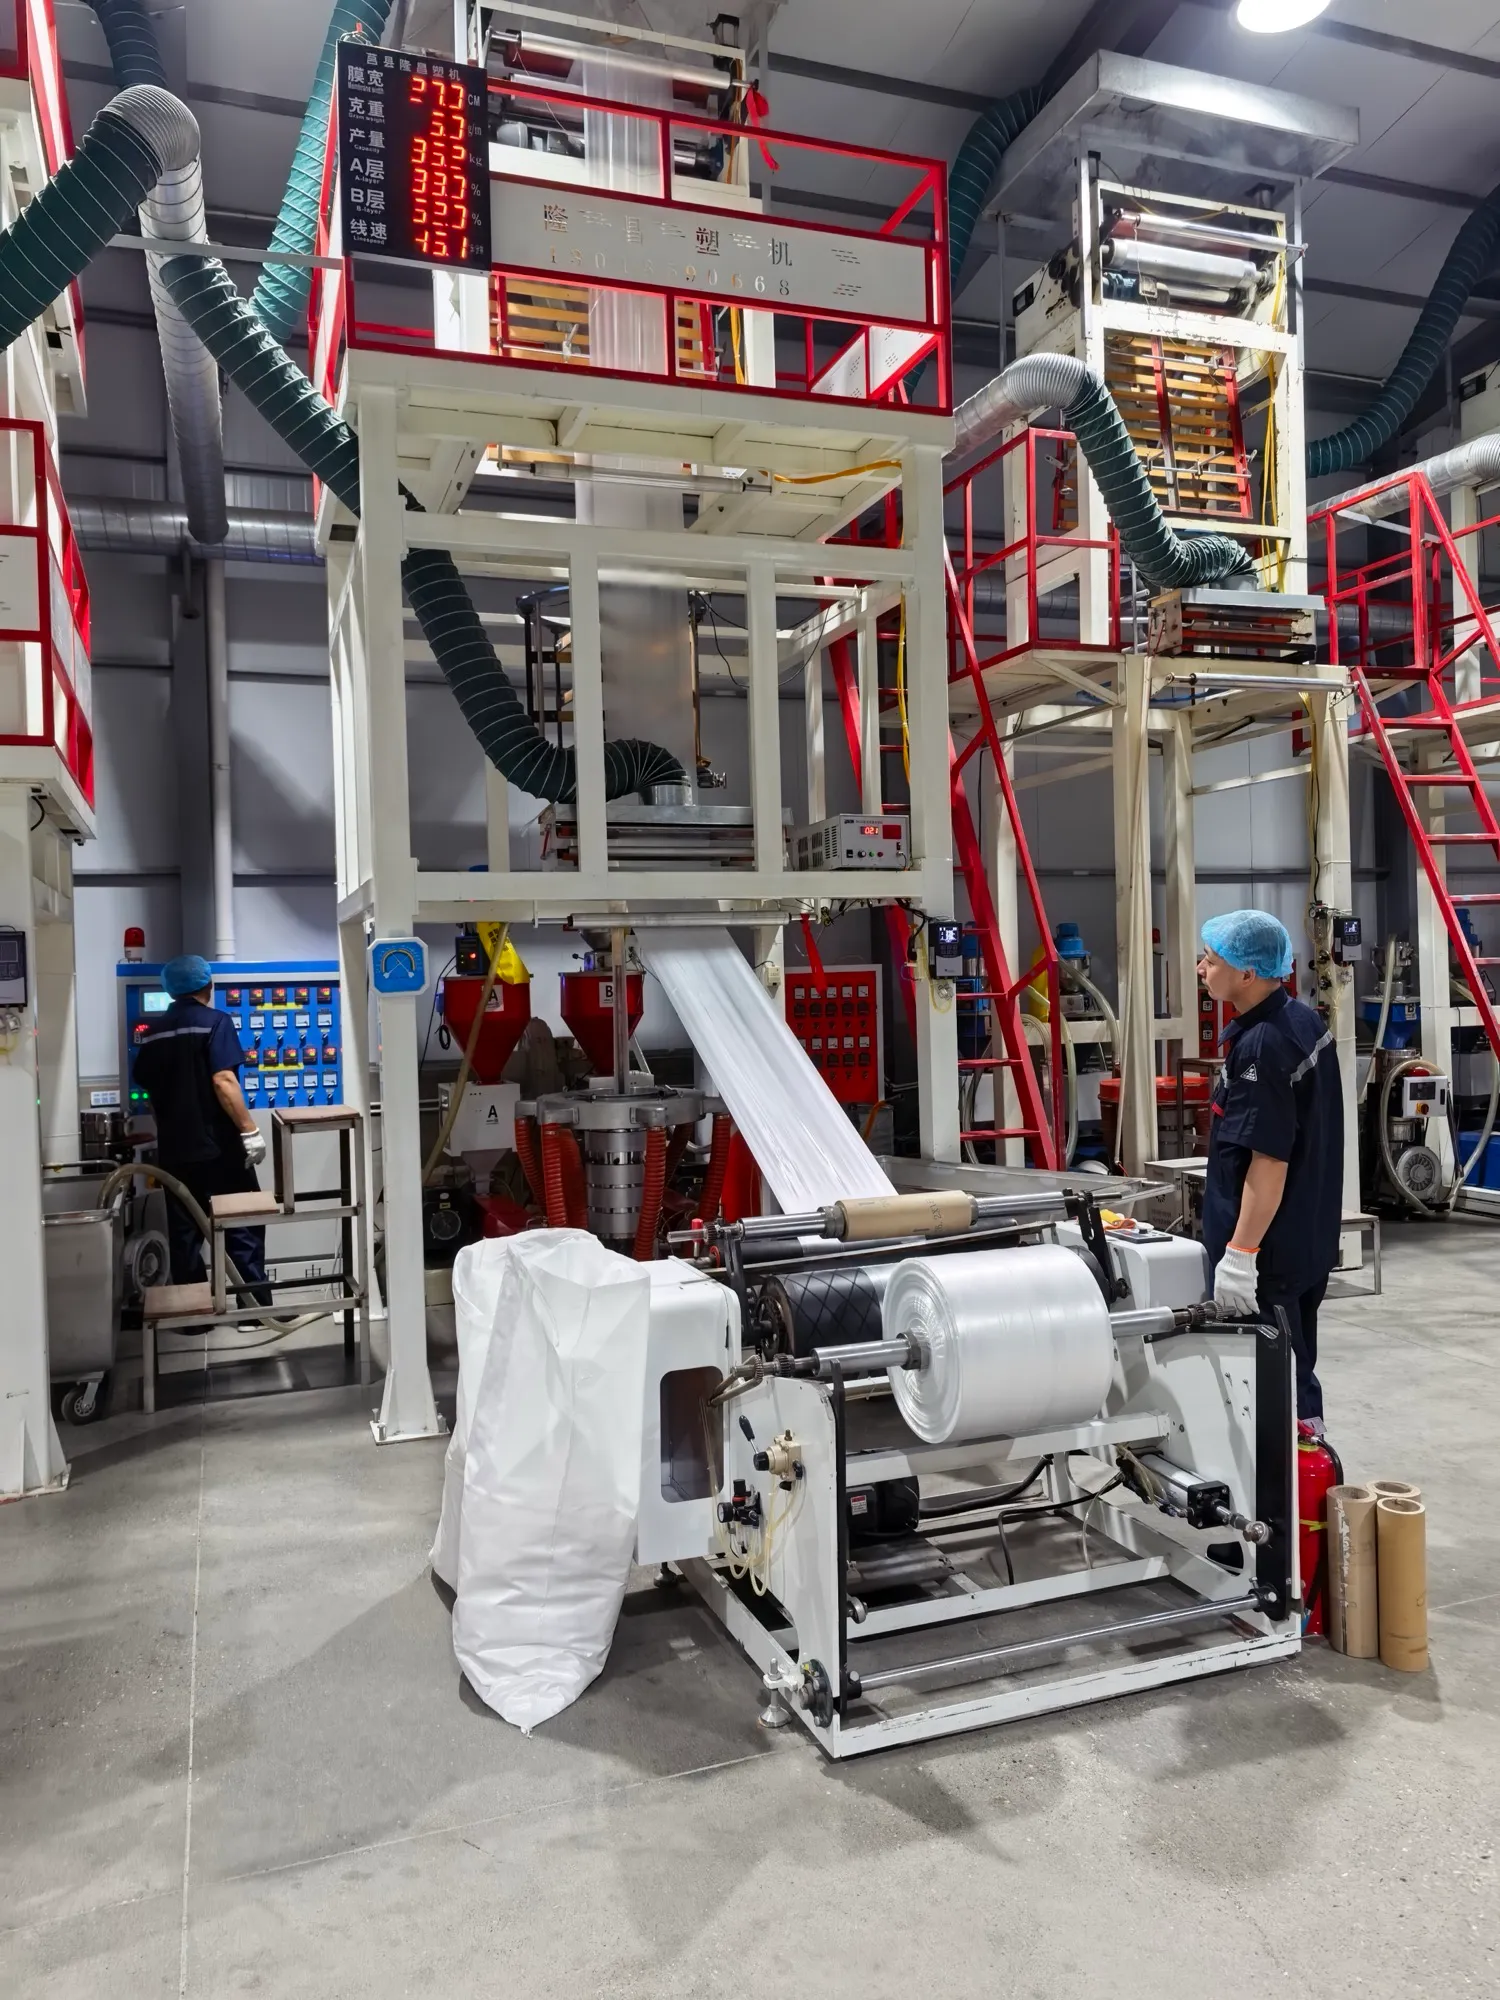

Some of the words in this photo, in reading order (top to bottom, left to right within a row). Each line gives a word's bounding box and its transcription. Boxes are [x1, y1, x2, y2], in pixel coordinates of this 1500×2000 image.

[347, 65, 384, 87] 膜宽
[467, 94, 482, 107] CM
[348, 97, 385, 118] 克重
[348, 127, 386, 149] 产量
[354, 144, 380, 154] Capacity
[468, 153, 483, 166] kg
[350, 157, 385, 180] A层
[355, 175, 380, 184] A-layer
[471, 183, 481, 196] %
[350, 188, 386, 210] B层
[356, 206, 382, 215] B-layer
[472, 213, 482, 226] %
[350, 218, 387, 240] 线速
[488, 989, 499, 1002] A
[605, 985, 614, 998] B
[488, 1104, 498, 1119] A
